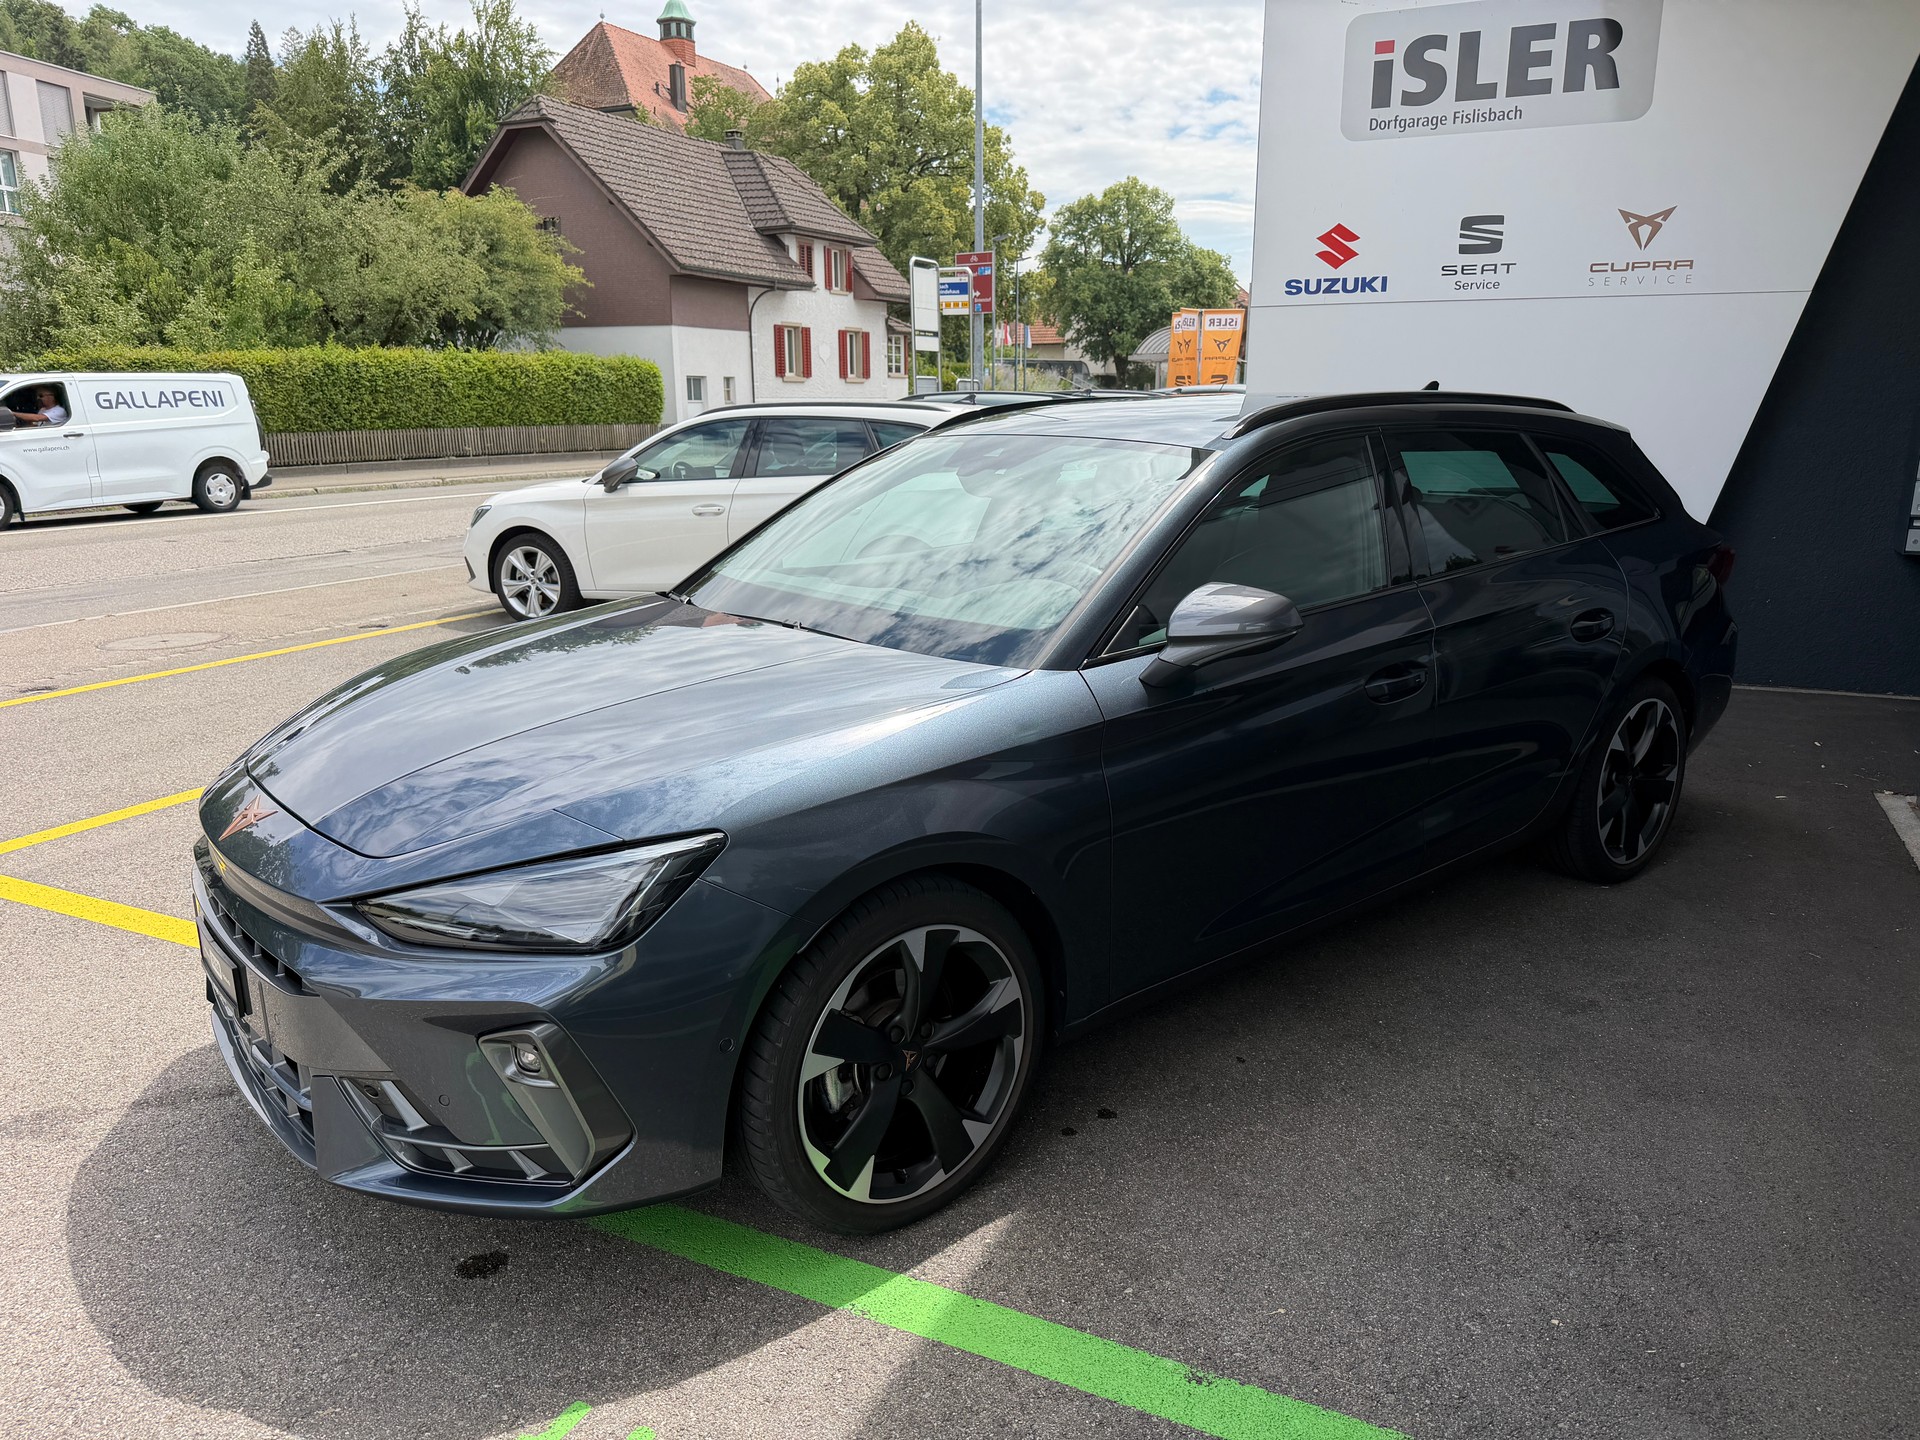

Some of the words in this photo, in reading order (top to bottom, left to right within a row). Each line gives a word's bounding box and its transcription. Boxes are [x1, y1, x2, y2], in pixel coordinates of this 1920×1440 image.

[1371, 18, 1623, 109] iSLER
[1369, 114, 1448, 133] Dorfgarage
[1452, 105, 1523, 125] Fislisbach
[1441, 262, 1517, 276] SEAT
[1589, 259, 1694, 273] CUPRA
[1284, 275, 1388, 296] SUZUKI
[1454, 279, 1501, 291] Service
[1588, 274, 1693, 287] SERVICE
[94, 390, 225, 410] GALLAPENI
